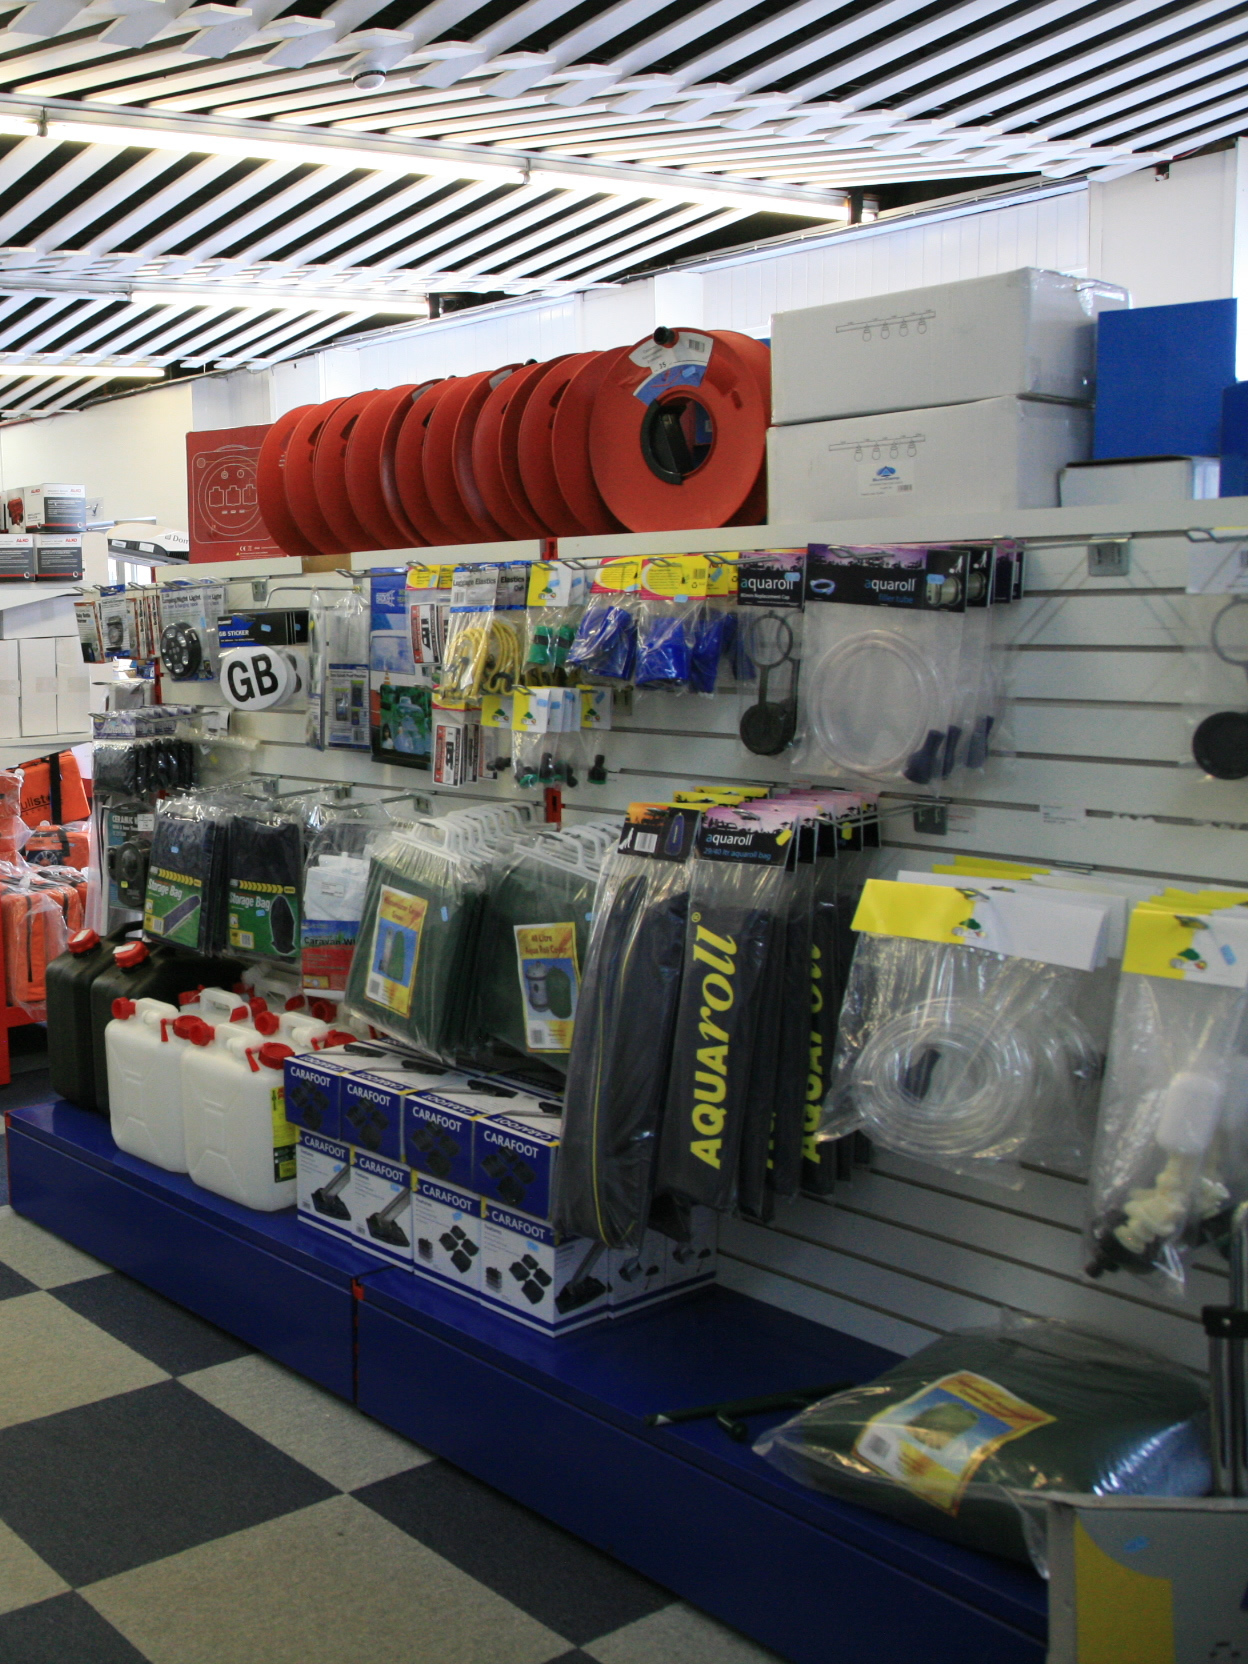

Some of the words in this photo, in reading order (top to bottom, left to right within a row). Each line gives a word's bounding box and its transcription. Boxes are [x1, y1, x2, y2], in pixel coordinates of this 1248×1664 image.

[500, 575, 525, 584] Elastics
[864, 577, 917, 592] aquaroll
[227, 653, 279, 703] GB
[705, 833, 754, 846] aquaroll
[147, 878, 169, 896] Storage
[169, 885, 183, 901] Bag
[229, 892, 254, 909] Storage
[255, 896, 271, 911] Bag
[689, 925, 738, 1170] AQUAroll
[290, 1066, 331, 1088] CARAFOOT
[347, 1084, 392, 1107] CARAFOOT
[412, 1106, 462, 1133] CARAFOOT
[304, 1136, 346, 1159] CARAFOOT
[483, 1130, 540, 1159] CARAFOOT
[359, 1158, 404, 1181] CARAFOOT
[422, 1184, 473, 1212] CARAFOOT
[491, 1211, 546, 1240] CARAFOOT
